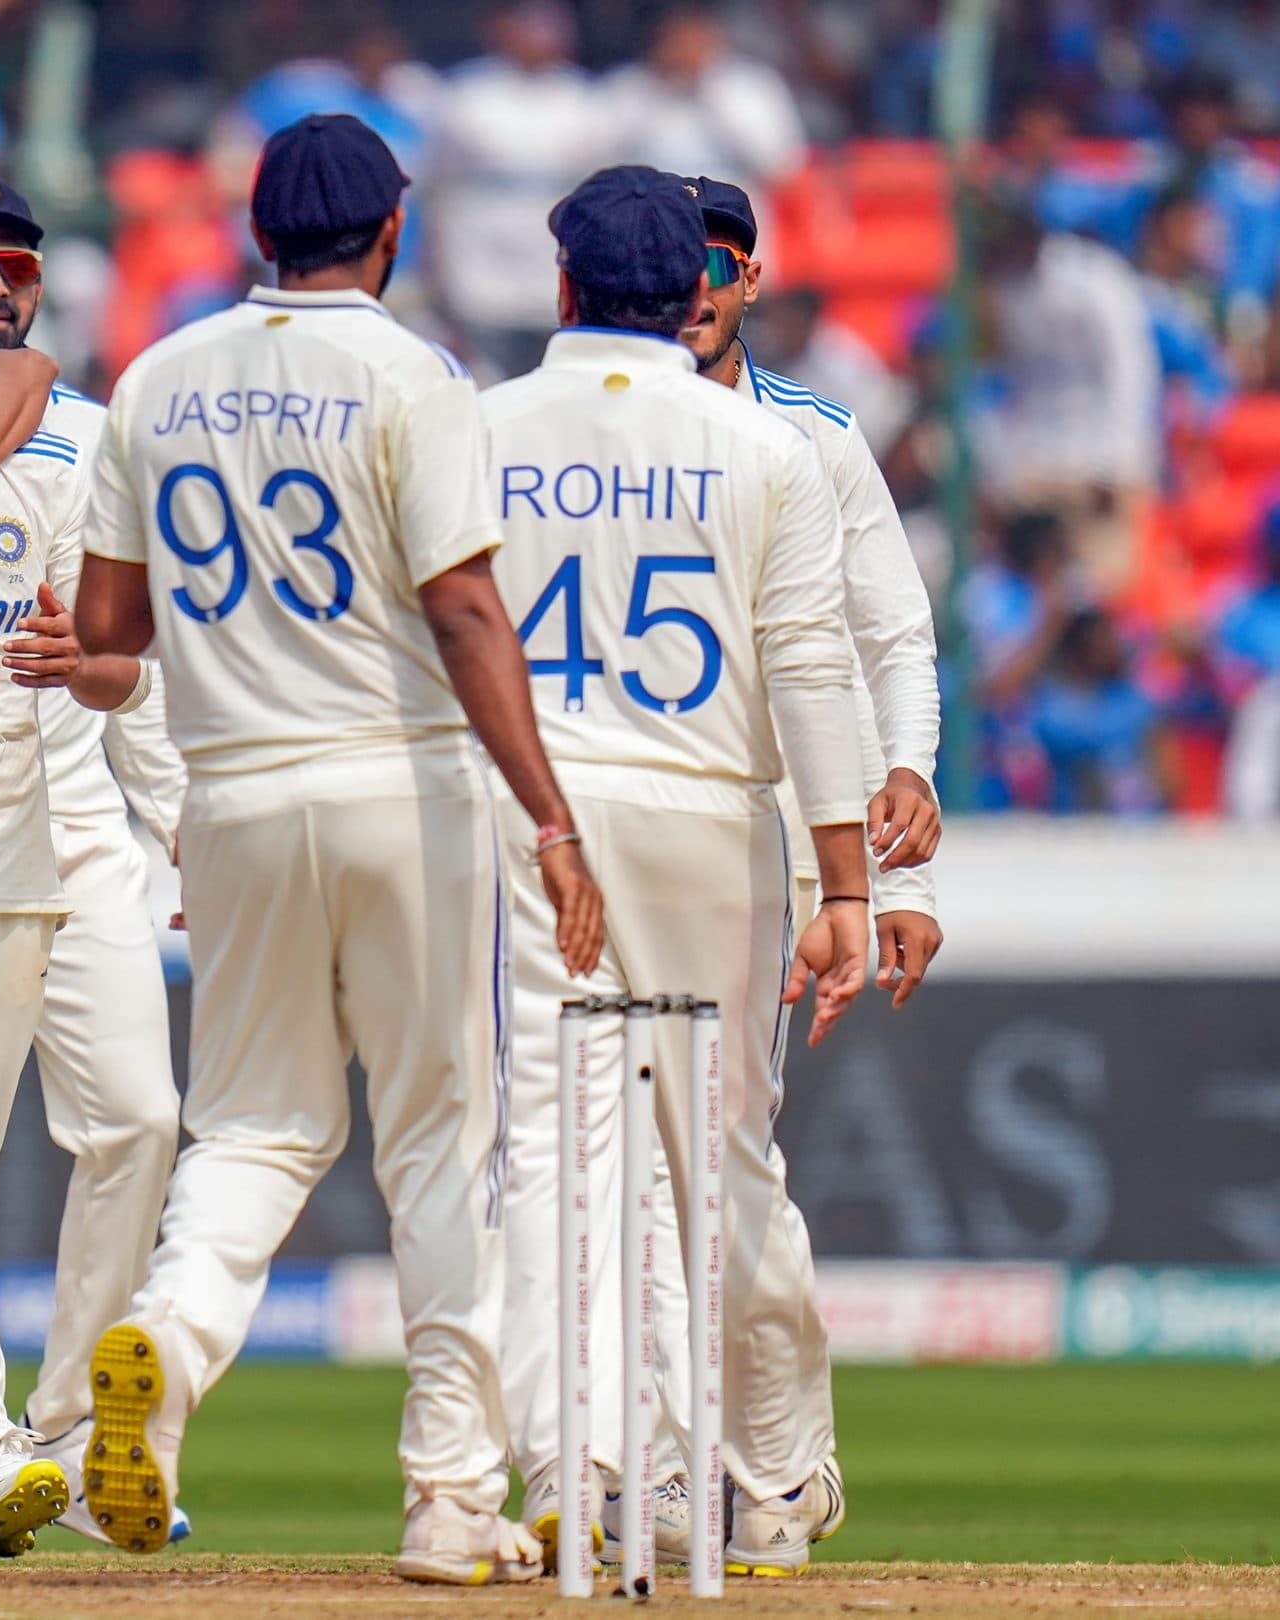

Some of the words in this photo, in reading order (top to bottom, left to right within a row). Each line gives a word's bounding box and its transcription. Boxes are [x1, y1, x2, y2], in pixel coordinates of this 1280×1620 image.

[153, 389, 363, 444] JASPRIT
[501, 463, 725, 524] ROHIT
[156, 462, 355, 624] 93
[517, 554, 724, 715] 45
[706, 1039, 718, 1078] Bank
[707, 1234, 719, 1274] Bank
[707, 1442, 719, 1484] Bank
